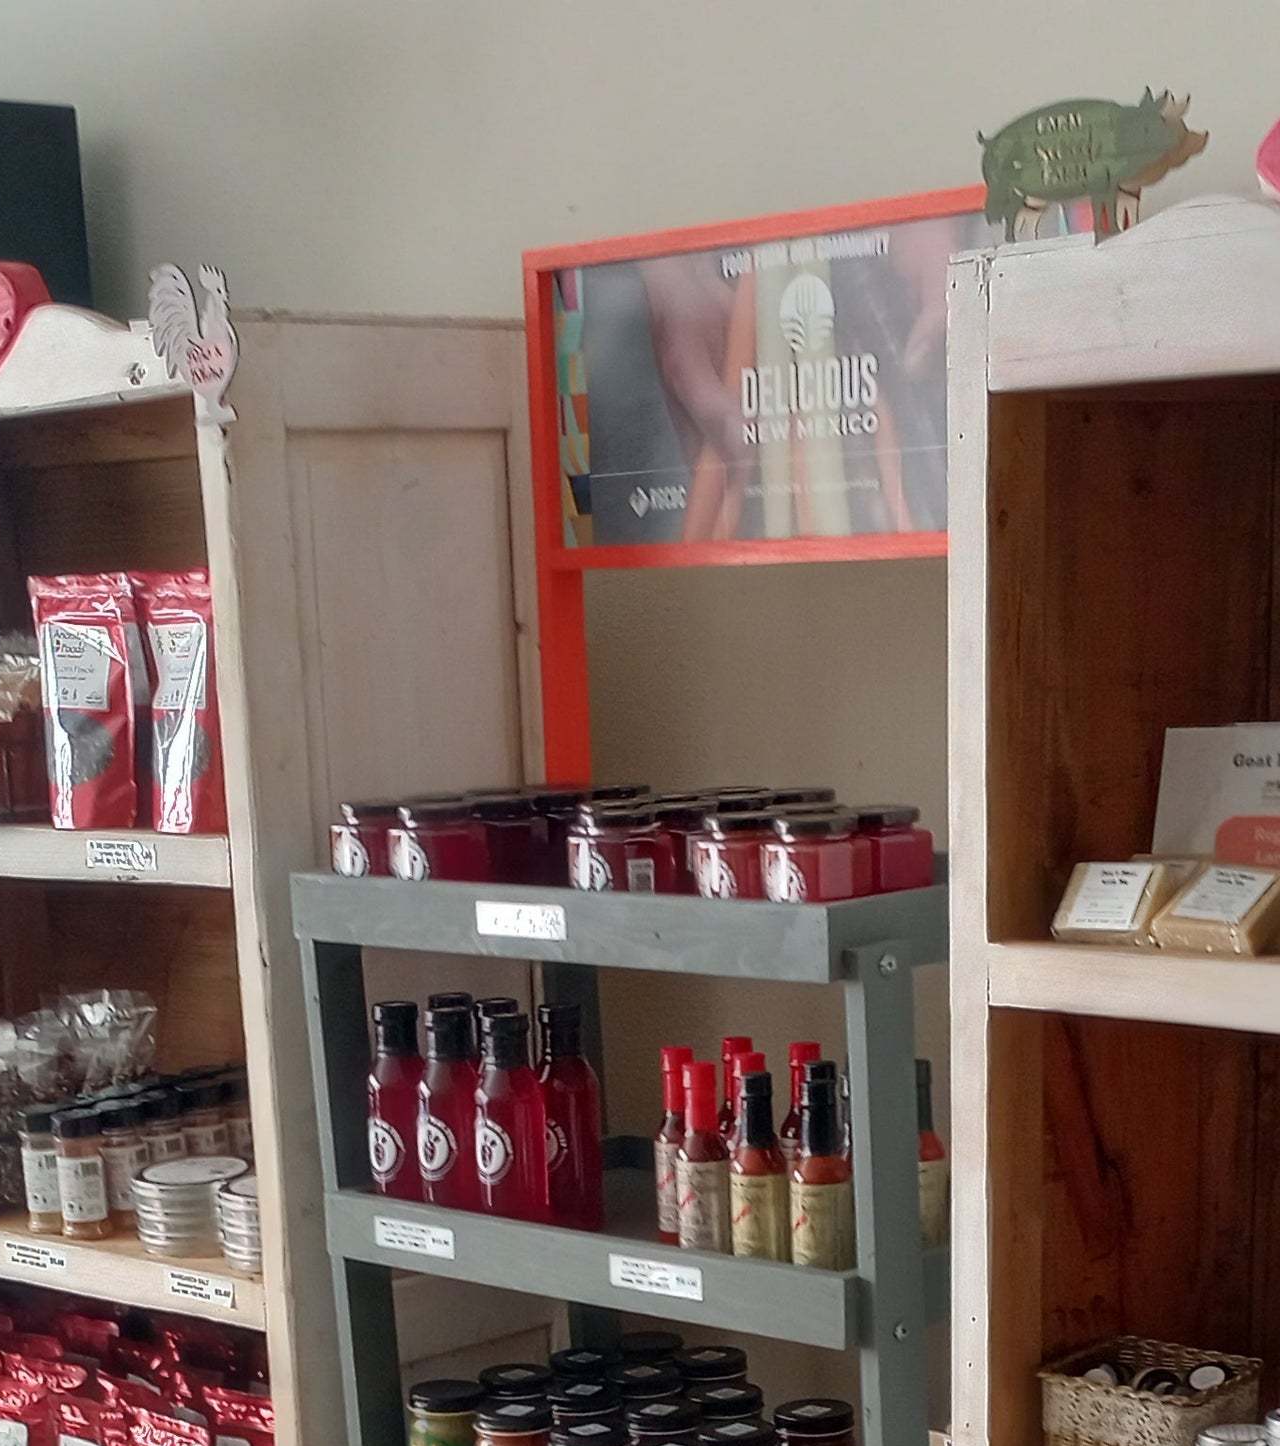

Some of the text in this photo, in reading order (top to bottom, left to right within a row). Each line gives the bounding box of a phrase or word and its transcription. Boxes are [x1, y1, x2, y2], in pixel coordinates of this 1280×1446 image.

[816, 231, 890, 259] COMMUNITY
[741, 352, 879, 418] DELICIOUS
[742, 410, 879, 445] NEW MEXICO
[1233, 753, 1272, 768] Goat
